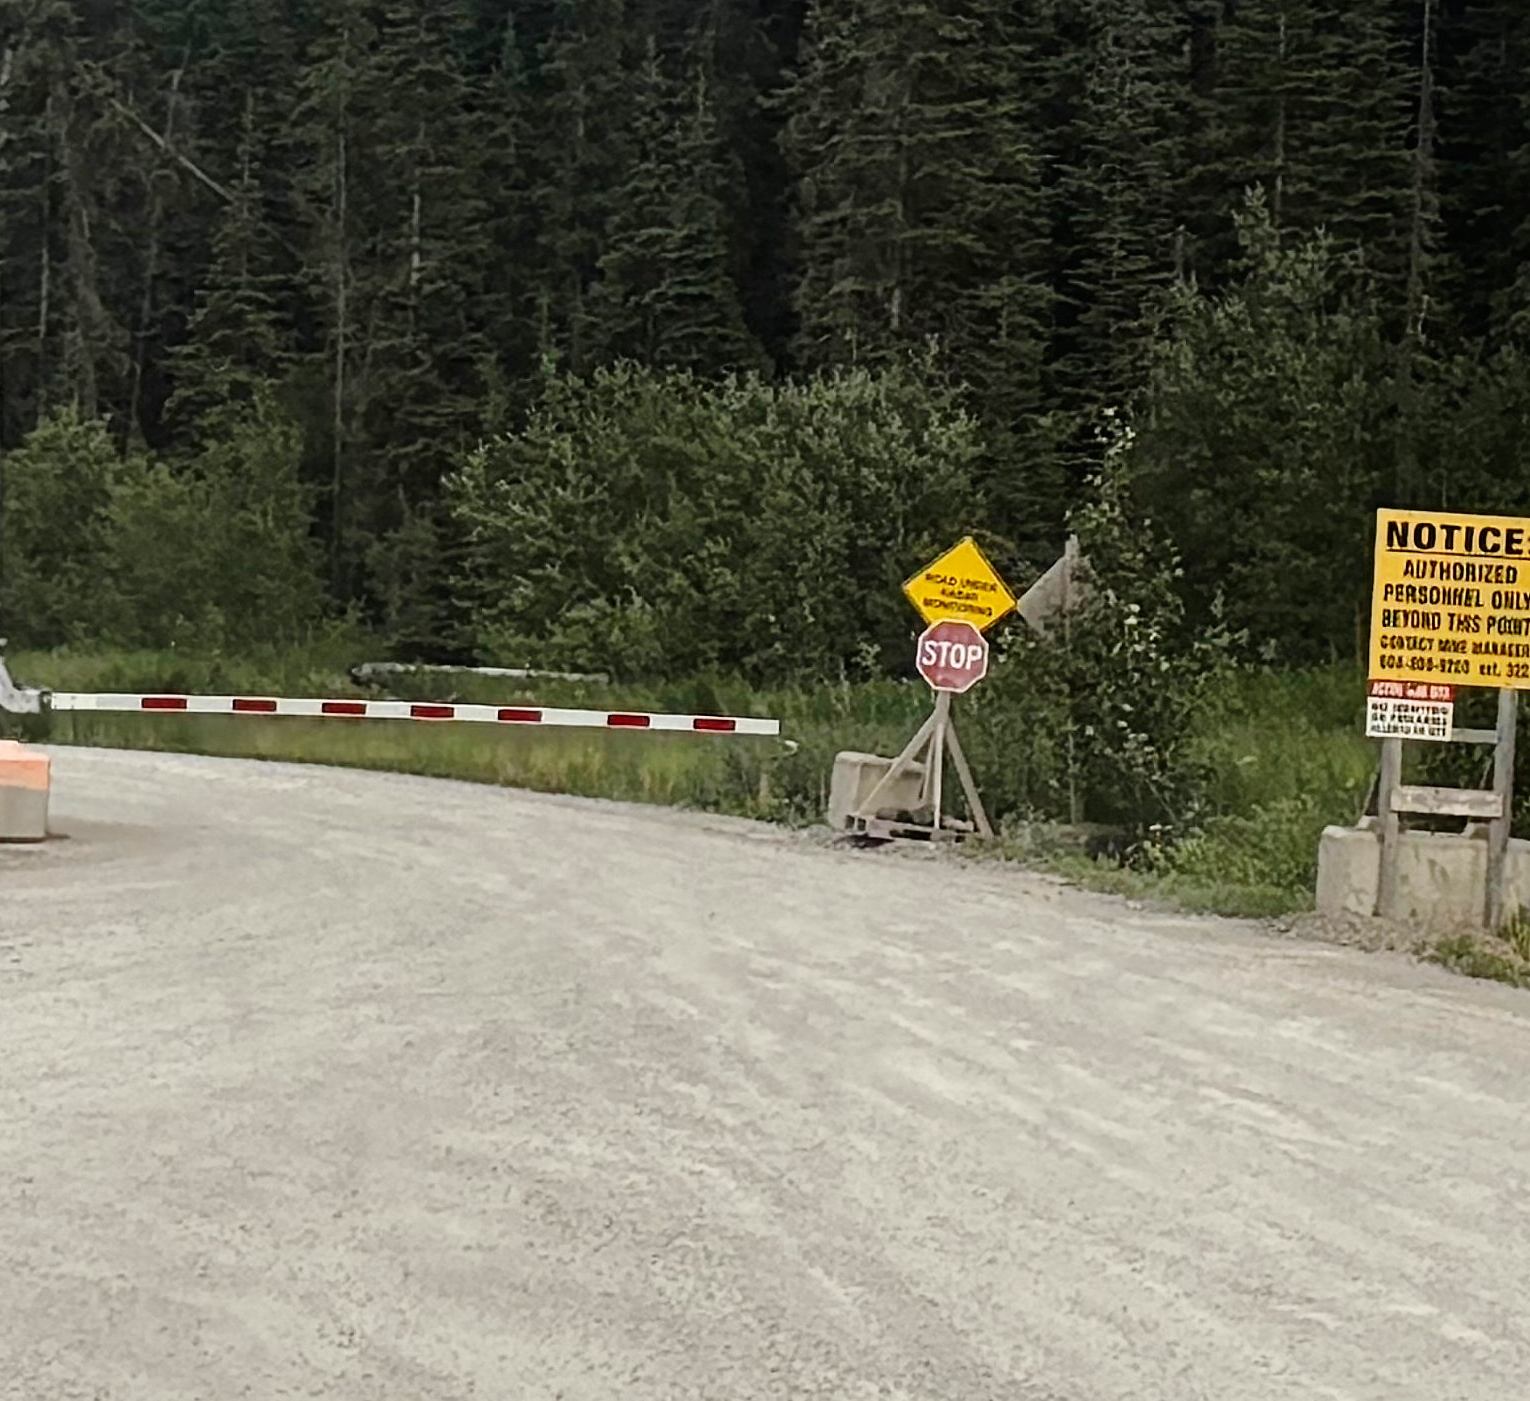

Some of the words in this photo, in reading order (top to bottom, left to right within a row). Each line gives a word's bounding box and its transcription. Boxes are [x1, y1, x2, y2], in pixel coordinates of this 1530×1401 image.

[1403, 559, 1518, 584] AUTHORIZED
[1383, 583, 1484, 607] PERSONNEL
[1381, 608, 1441, 630] BEYOND
[1447, 612, 1482, 633] THIS
[921, 639, 983, 671] STOP
